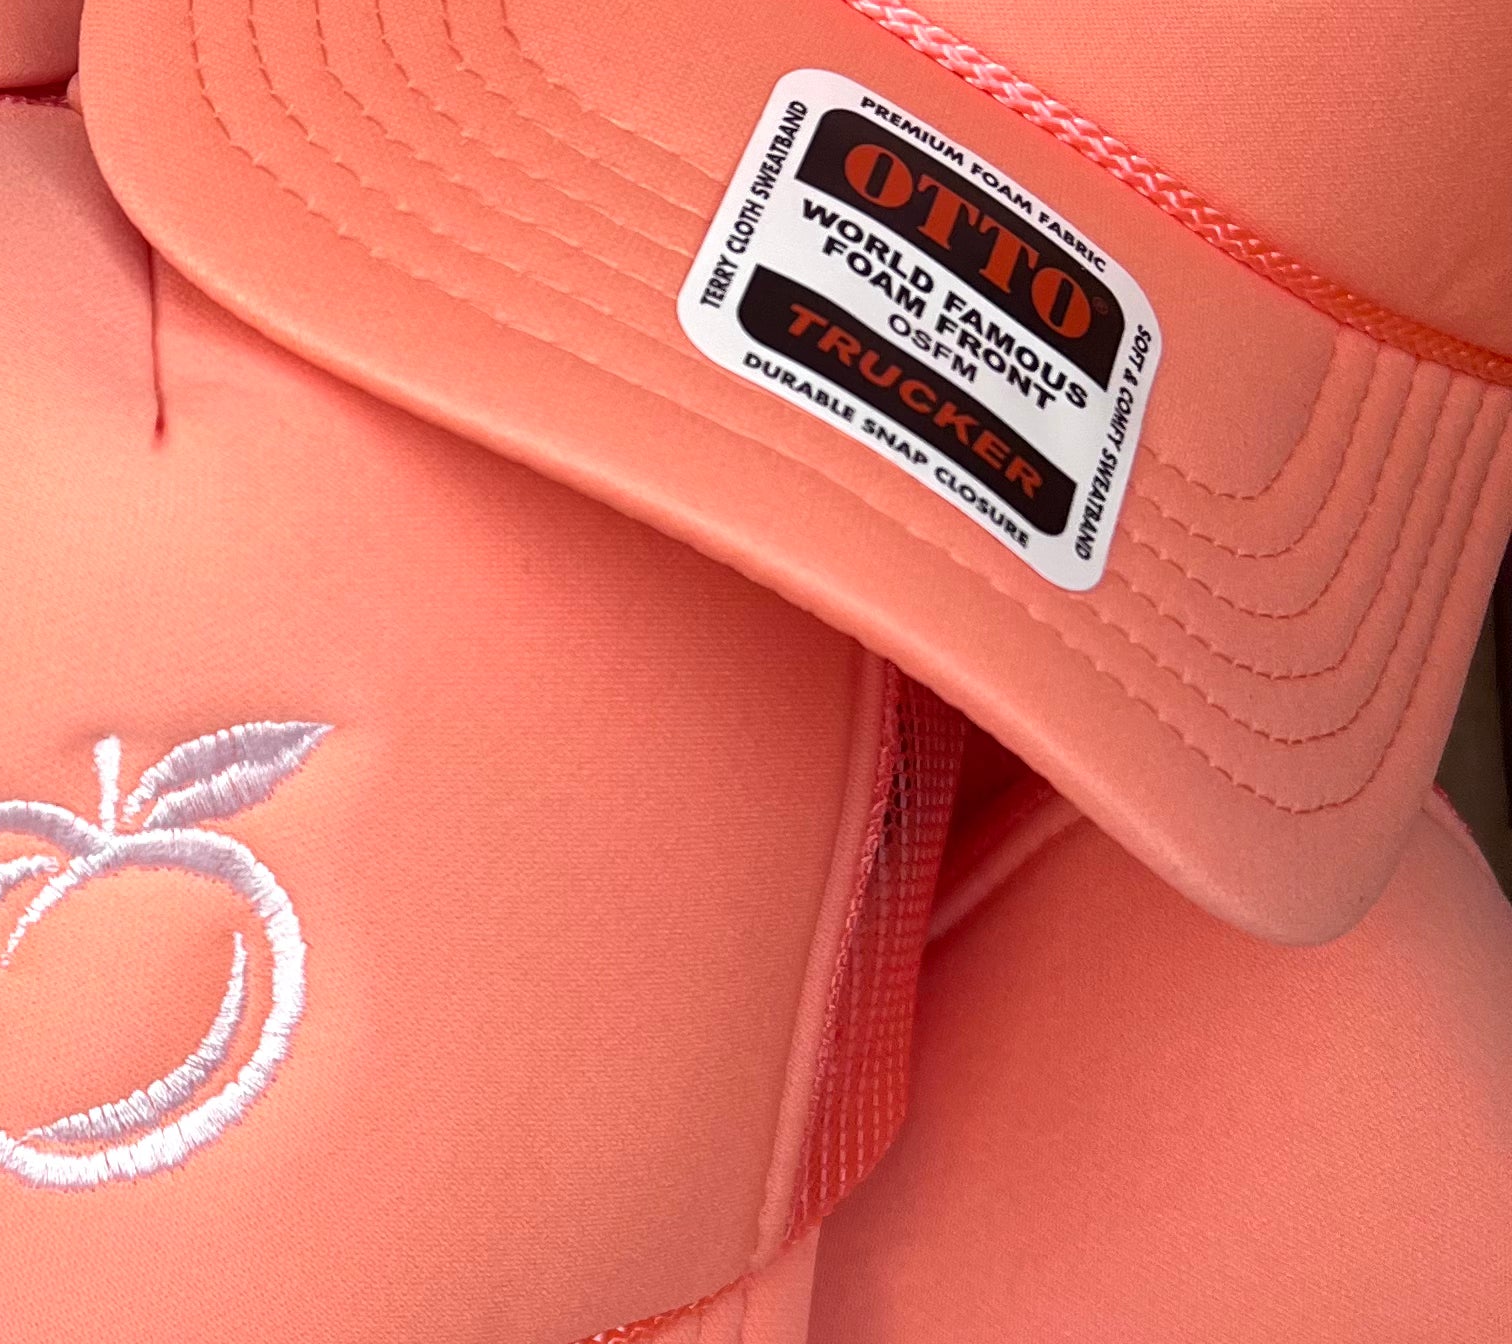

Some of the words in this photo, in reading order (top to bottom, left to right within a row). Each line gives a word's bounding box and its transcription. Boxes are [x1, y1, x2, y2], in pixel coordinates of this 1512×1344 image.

[701, 252, 739, 310] TERRY
[725, 199, 765, 255] CLOTH
[756, 100, 809, 200] SWEATBAND
[860, 96, 965, 165] PREMIUM
[970, 161, 1033, 214] FOAM
[1038, 212, 1107, 273] FABRIC
[801, 198, 935, 295] WORLD
[943, 290, 1088, 410] FAMOUS
[822, 236, 927, 319] FOAM
[934, 314, 1057, 411] FRONT
[888, 313, 978, 383] OSFM
[1123, 368, 1138, 386] &
[1128, 324, 1152, 372] SOFT
[742, 353, 856, 423] DURABLE
[861, 418, 928, 466] SNAP
[934, 466, 1030, 549] CLOSURE
[787, 304, 1044, 499] TRUCKER
[1107, 387, 1134, 452] COMFY
[1074, 448, 1117, 560] SWEATBAND
